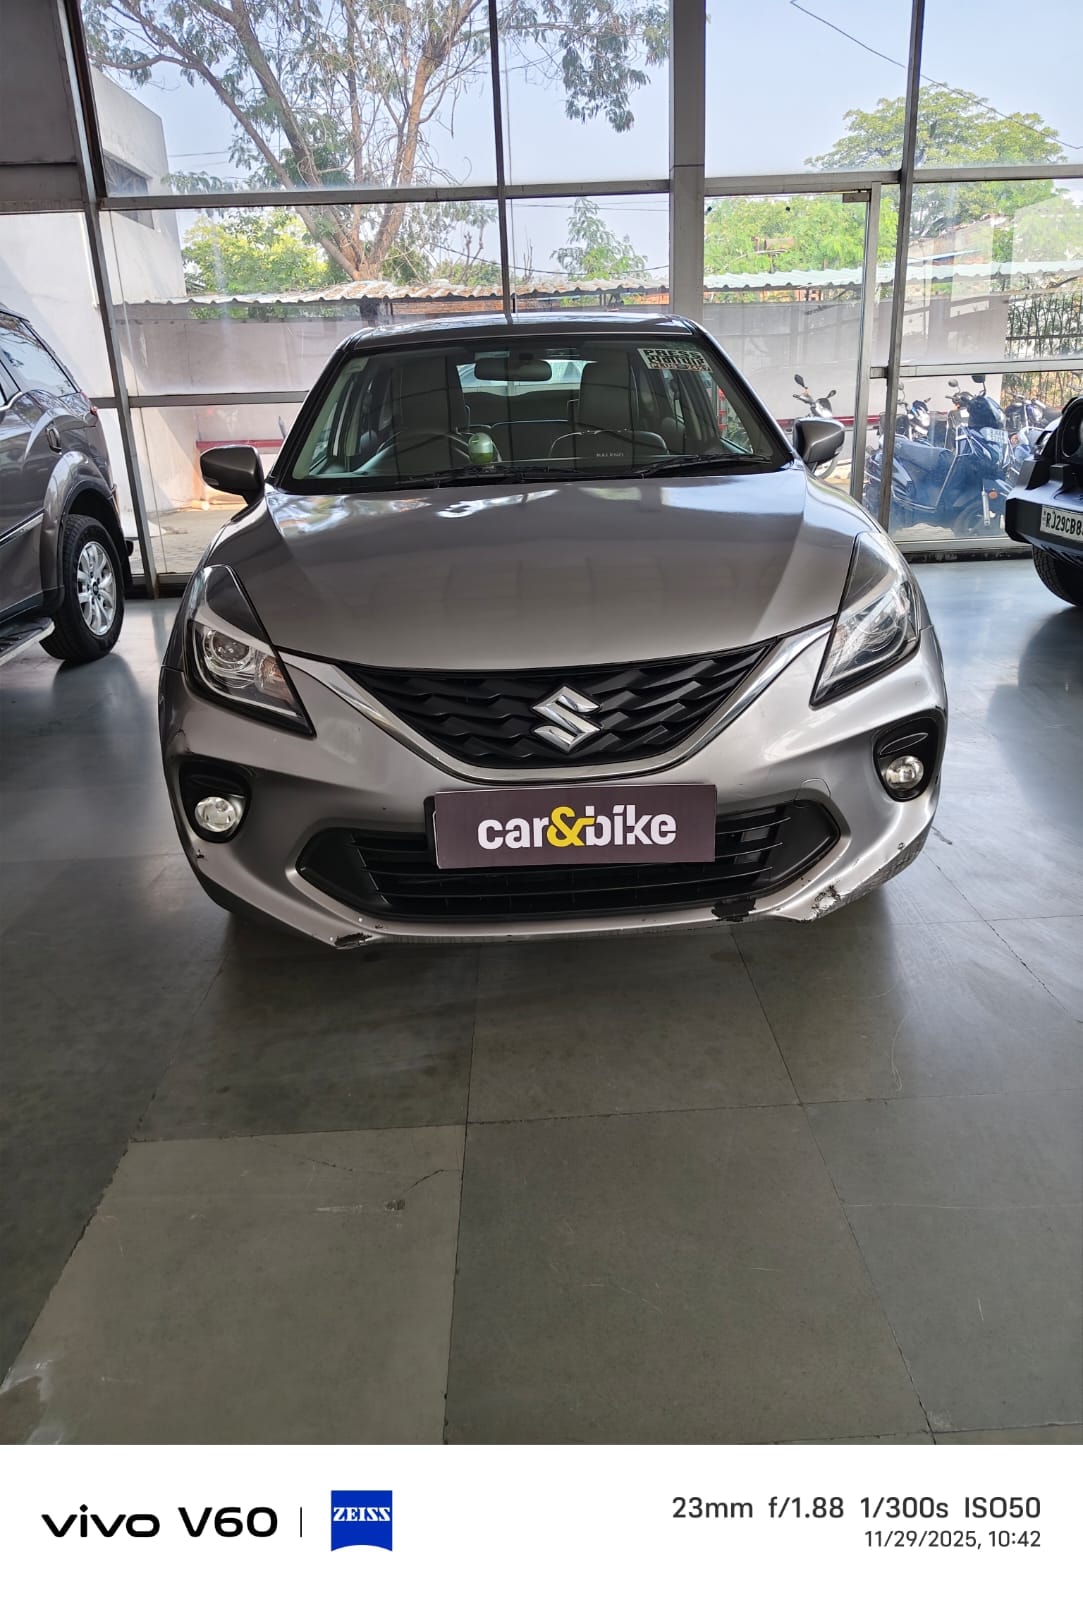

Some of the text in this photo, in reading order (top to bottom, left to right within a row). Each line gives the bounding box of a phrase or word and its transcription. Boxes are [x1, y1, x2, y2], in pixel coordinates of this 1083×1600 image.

[642, 349, 701, 360] PRESS
[1046, 511, 1083, 536] RJ29CB8
[477, 804, 677, 850] car&bike
